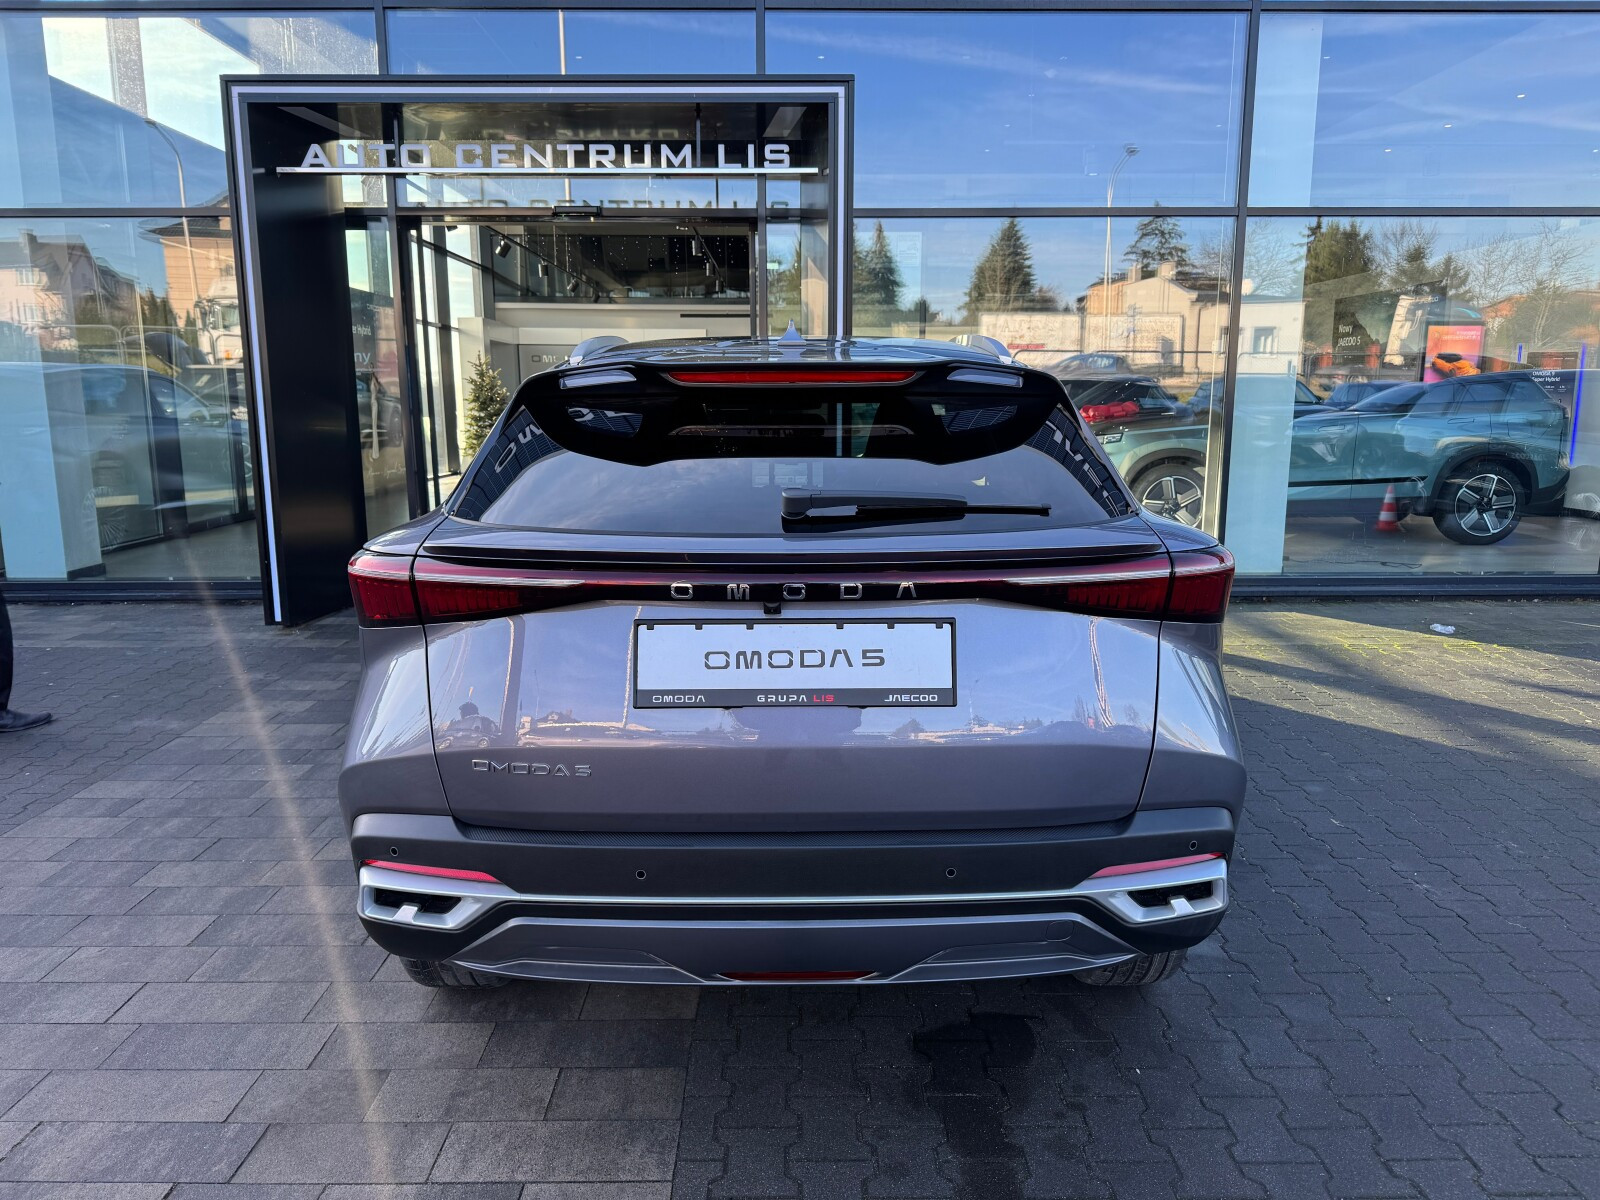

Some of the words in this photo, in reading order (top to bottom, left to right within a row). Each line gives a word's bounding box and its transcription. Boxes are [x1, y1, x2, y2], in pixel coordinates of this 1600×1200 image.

[300, 143, 432, 168] AUTO
[455, 143, 693, 168] CENTRUM
[717, 143, 791, 168] LIS
[1338, 324, 1353, 334] Nowy
[1337, 336, 1357, 346] JAECOO
[670, 581, 918, 600] OMODA
[704, 649, 853, 670] OMODA
[861, 648, 886, 667] 5
[652, 695, 706, 703] OMODA
[757, 694, 807, 703] GRUPA
[813, 694, 835, 702] LIS
[884, 694, 938, 702] JAECOO
[471, 759, 571, 777] OMODA
[574, 764, 592, 777] 5
